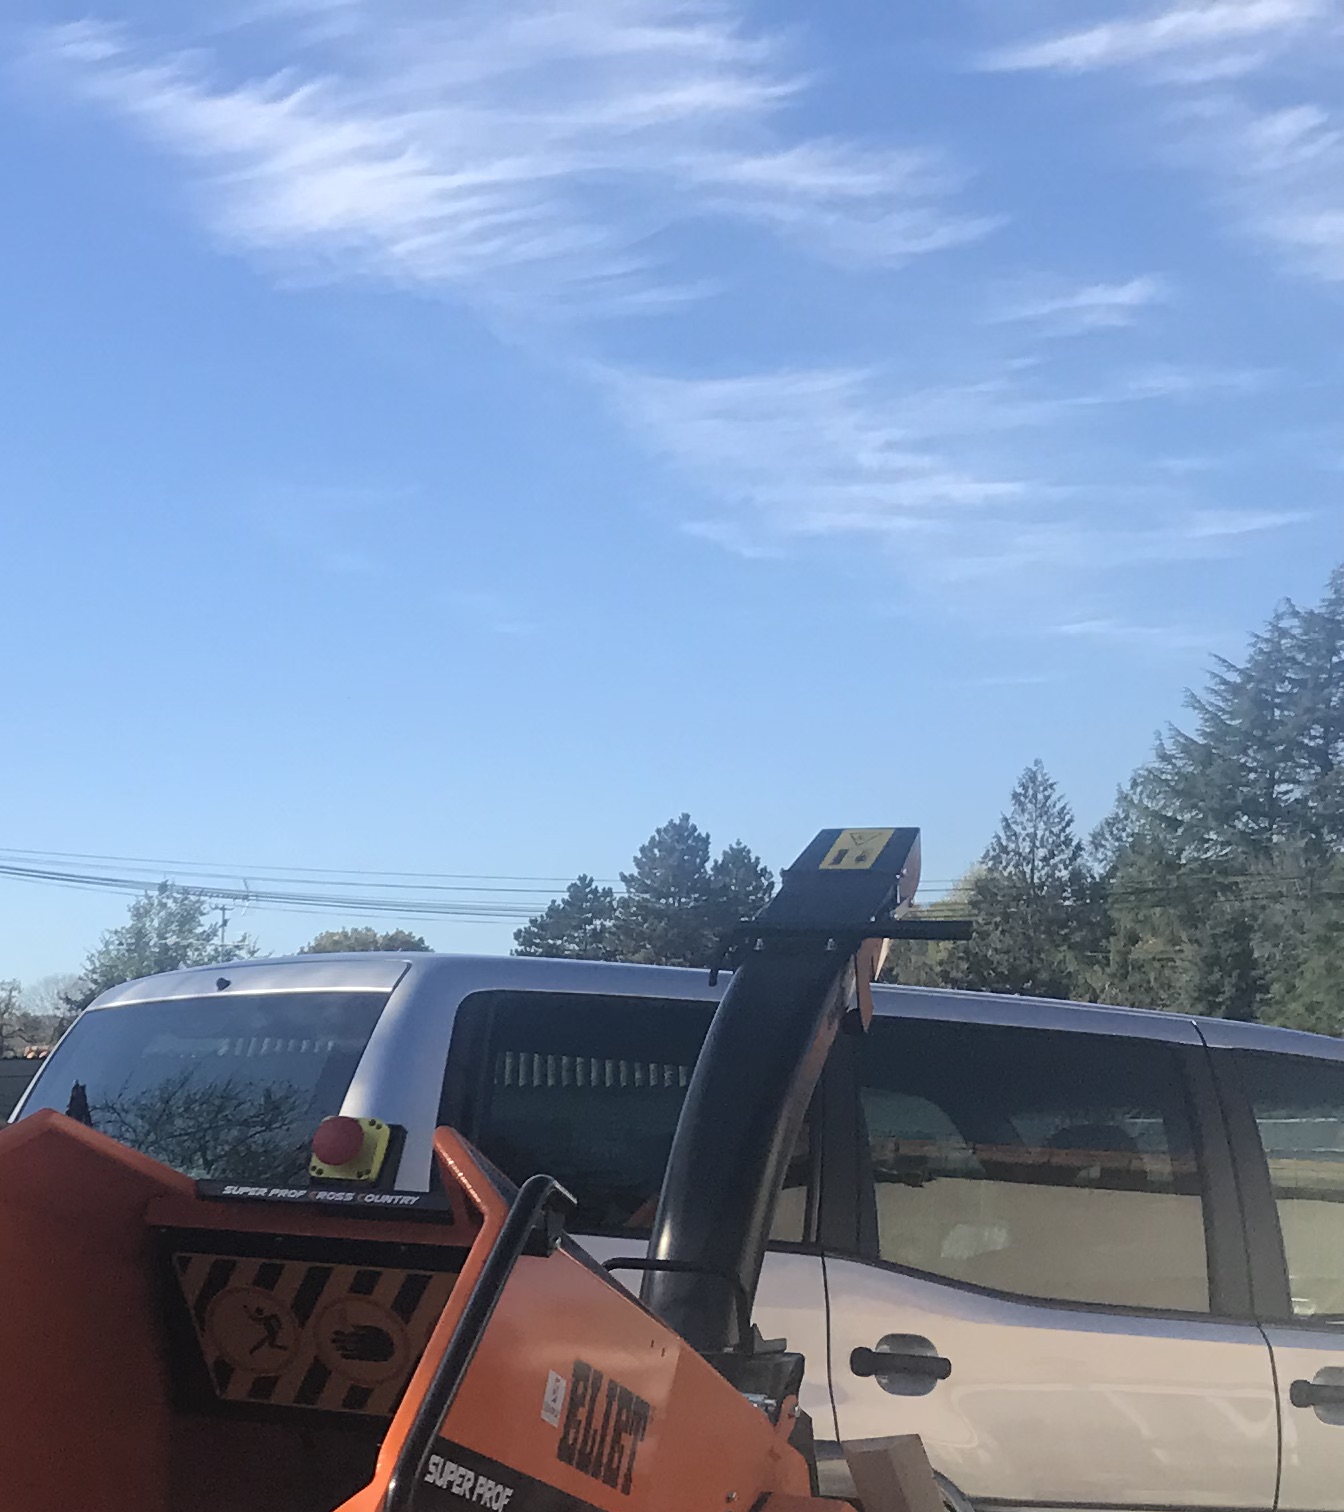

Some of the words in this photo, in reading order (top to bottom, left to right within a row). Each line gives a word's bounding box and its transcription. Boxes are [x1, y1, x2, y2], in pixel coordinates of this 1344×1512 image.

[222, 1185, 267, 1197] SUPER
[268, 1188, 307, 1198] PROF
[309, 1191, 355, 1201] CROSS
[358, 1193, 420, 1205] COUNTRY
[424, 1454, 474, 1499] SUPER
[472, 1475, 514, 1512] PROF
